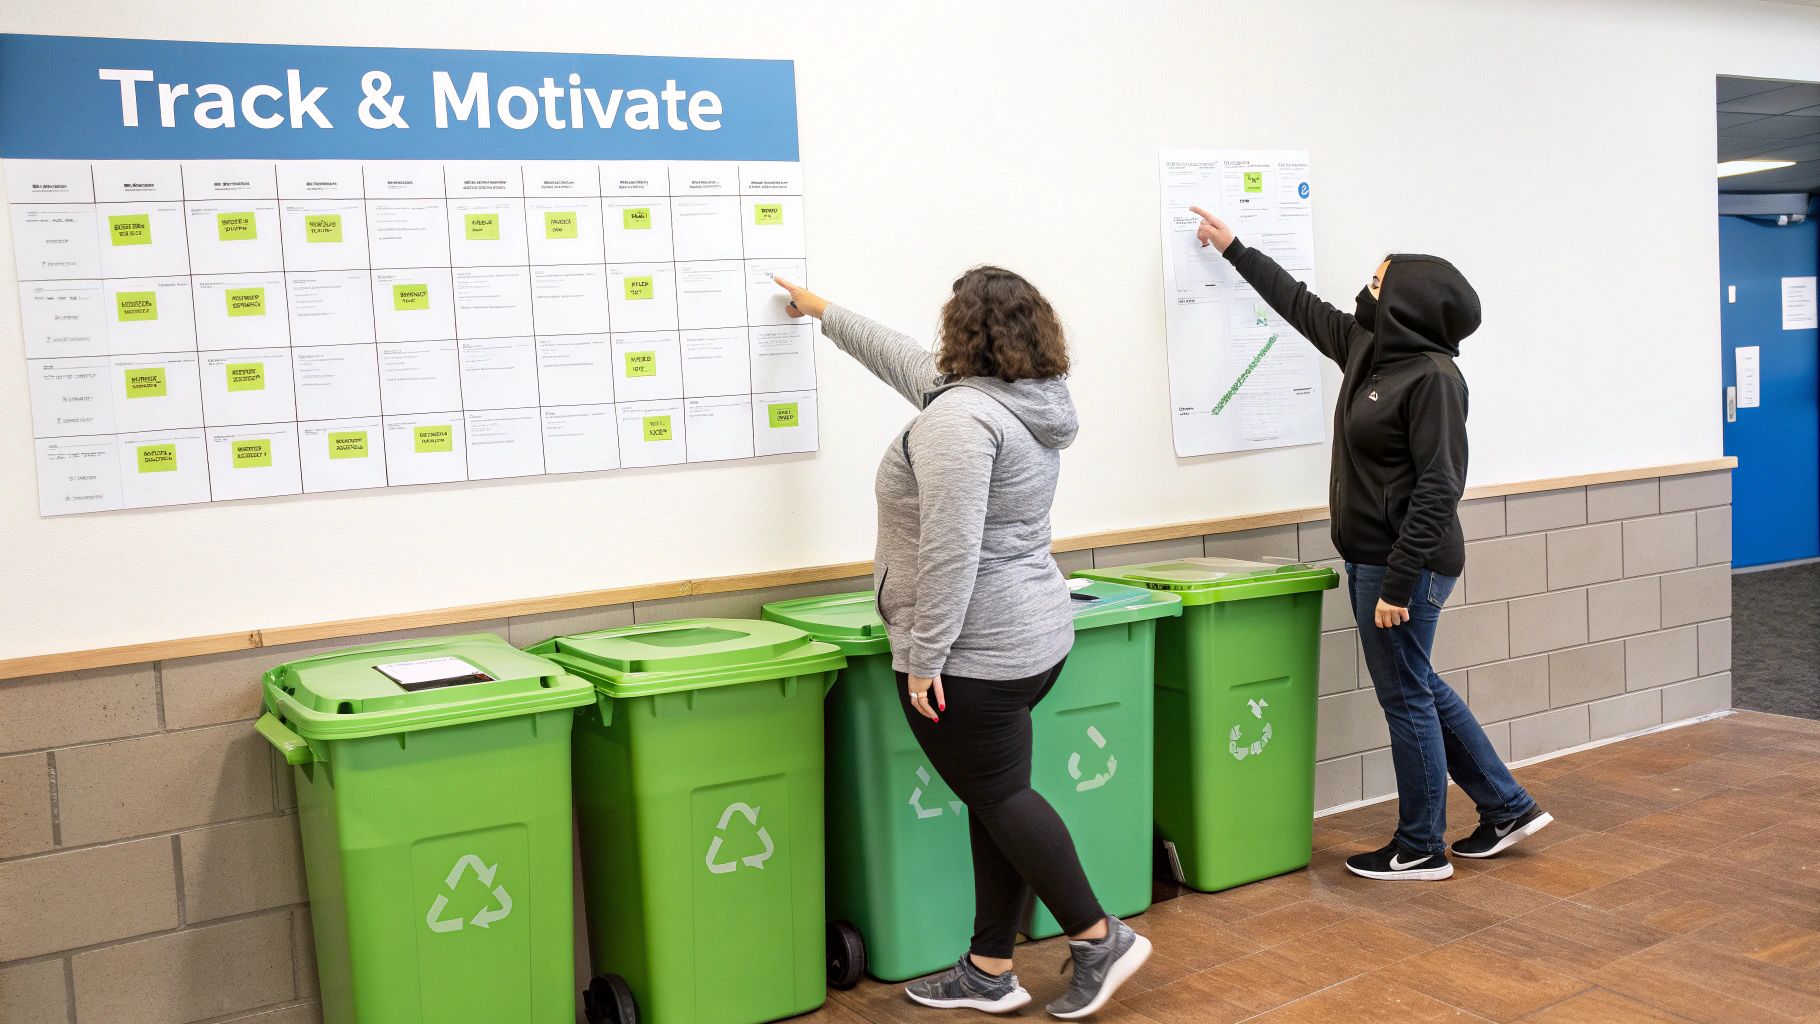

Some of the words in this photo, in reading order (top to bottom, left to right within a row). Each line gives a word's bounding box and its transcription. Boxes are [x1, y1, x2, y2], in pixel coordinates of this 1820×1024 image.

[99, 68, 334, 129] Track
[358, 70, 410, 130] &
[432, 71, 723, 131] Motivate
